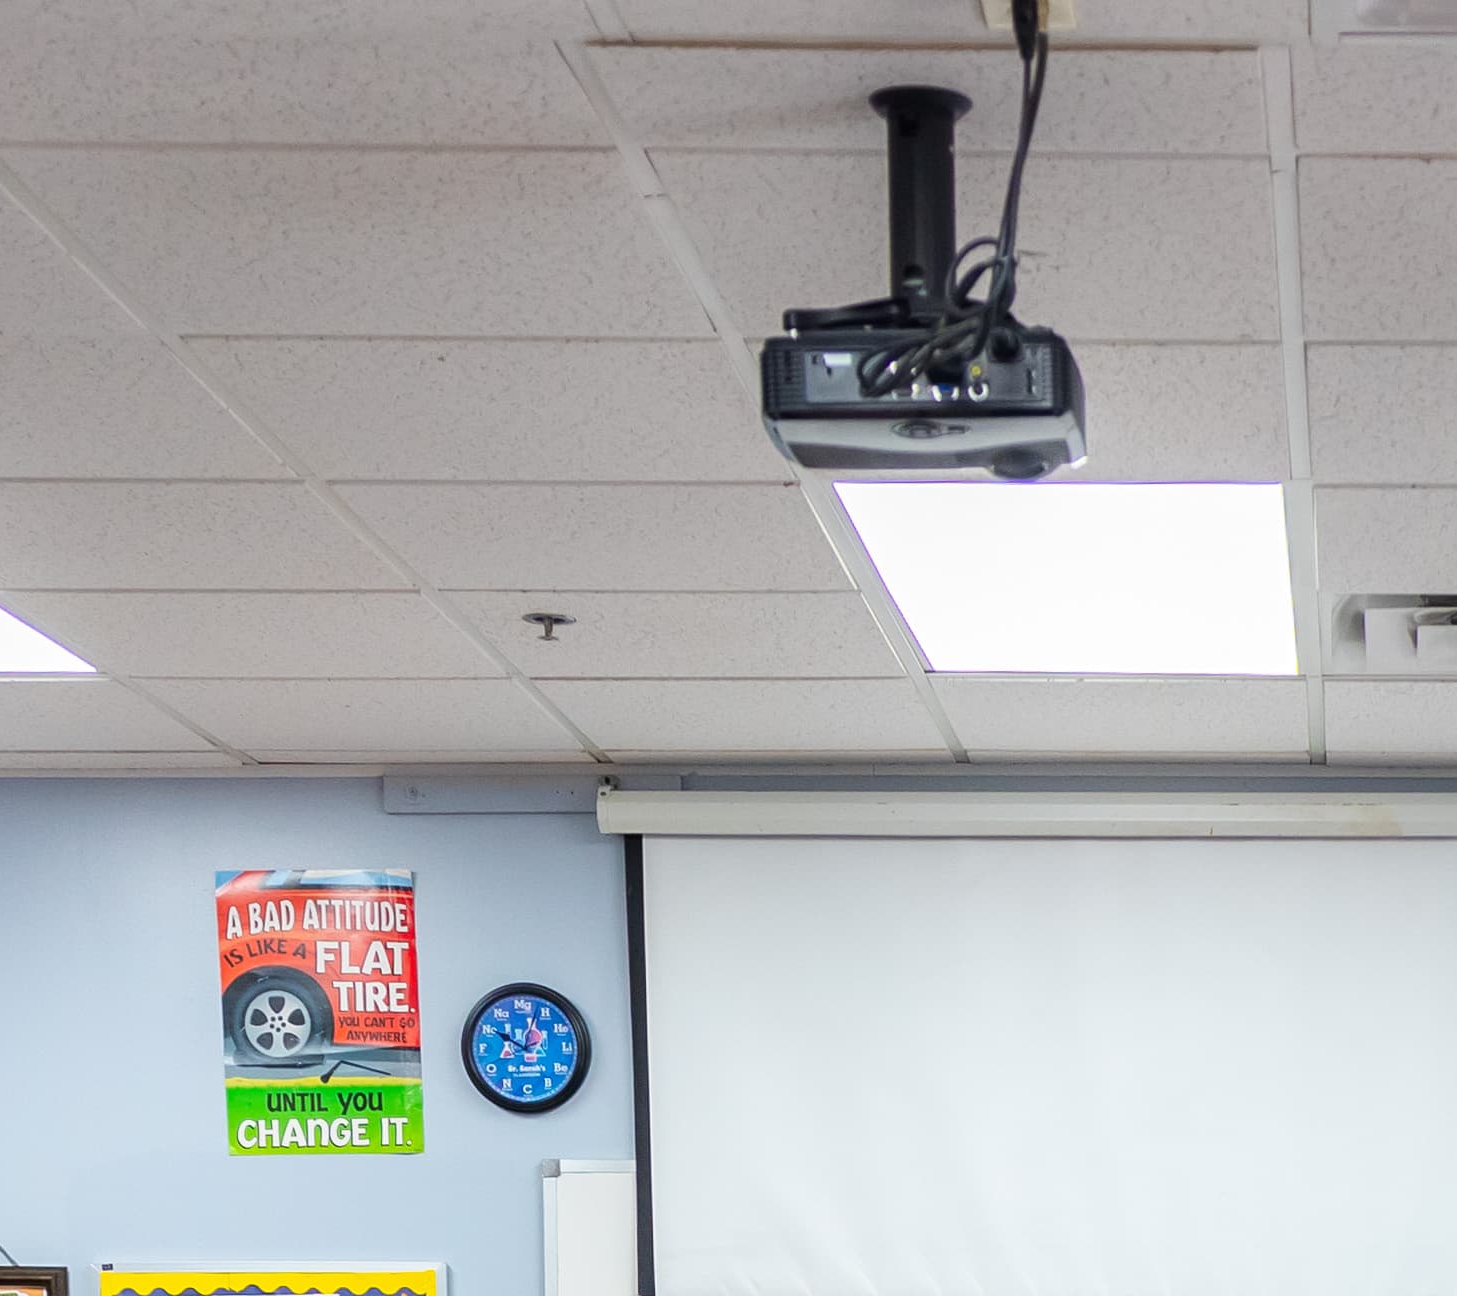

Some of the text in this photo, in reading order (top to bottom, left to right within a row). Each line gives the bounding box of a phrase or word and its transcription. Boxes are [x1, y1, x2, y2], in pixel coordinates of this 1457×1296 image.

[226, 898, 409, 940] A BAD ATTITUDE
[223, 939, 307, 968] IS LIKE A
[315, 940, 410, 976] FLAT
[332, 981, 416, 1014] TIRE.
[514, 999, 532, 1011] Mg
[493, 1008, 510, 1018] Na
[541, 1008, 550, 1018] H
[338, 1016, 415, 1029] YOU CAN'T GO
[346, 1030, 407, 1043] ANYWHERE
[486, 1064, 497, 1074] O
[502, 1078, 512, 1088] N
[522, 1084, 533, 1094] C
[544, 1078, 552, 1087] B
[267, 1091, 383, 1115] UNTIL YOU
[236, 1117, 413, 1149] CHANGE IT.
